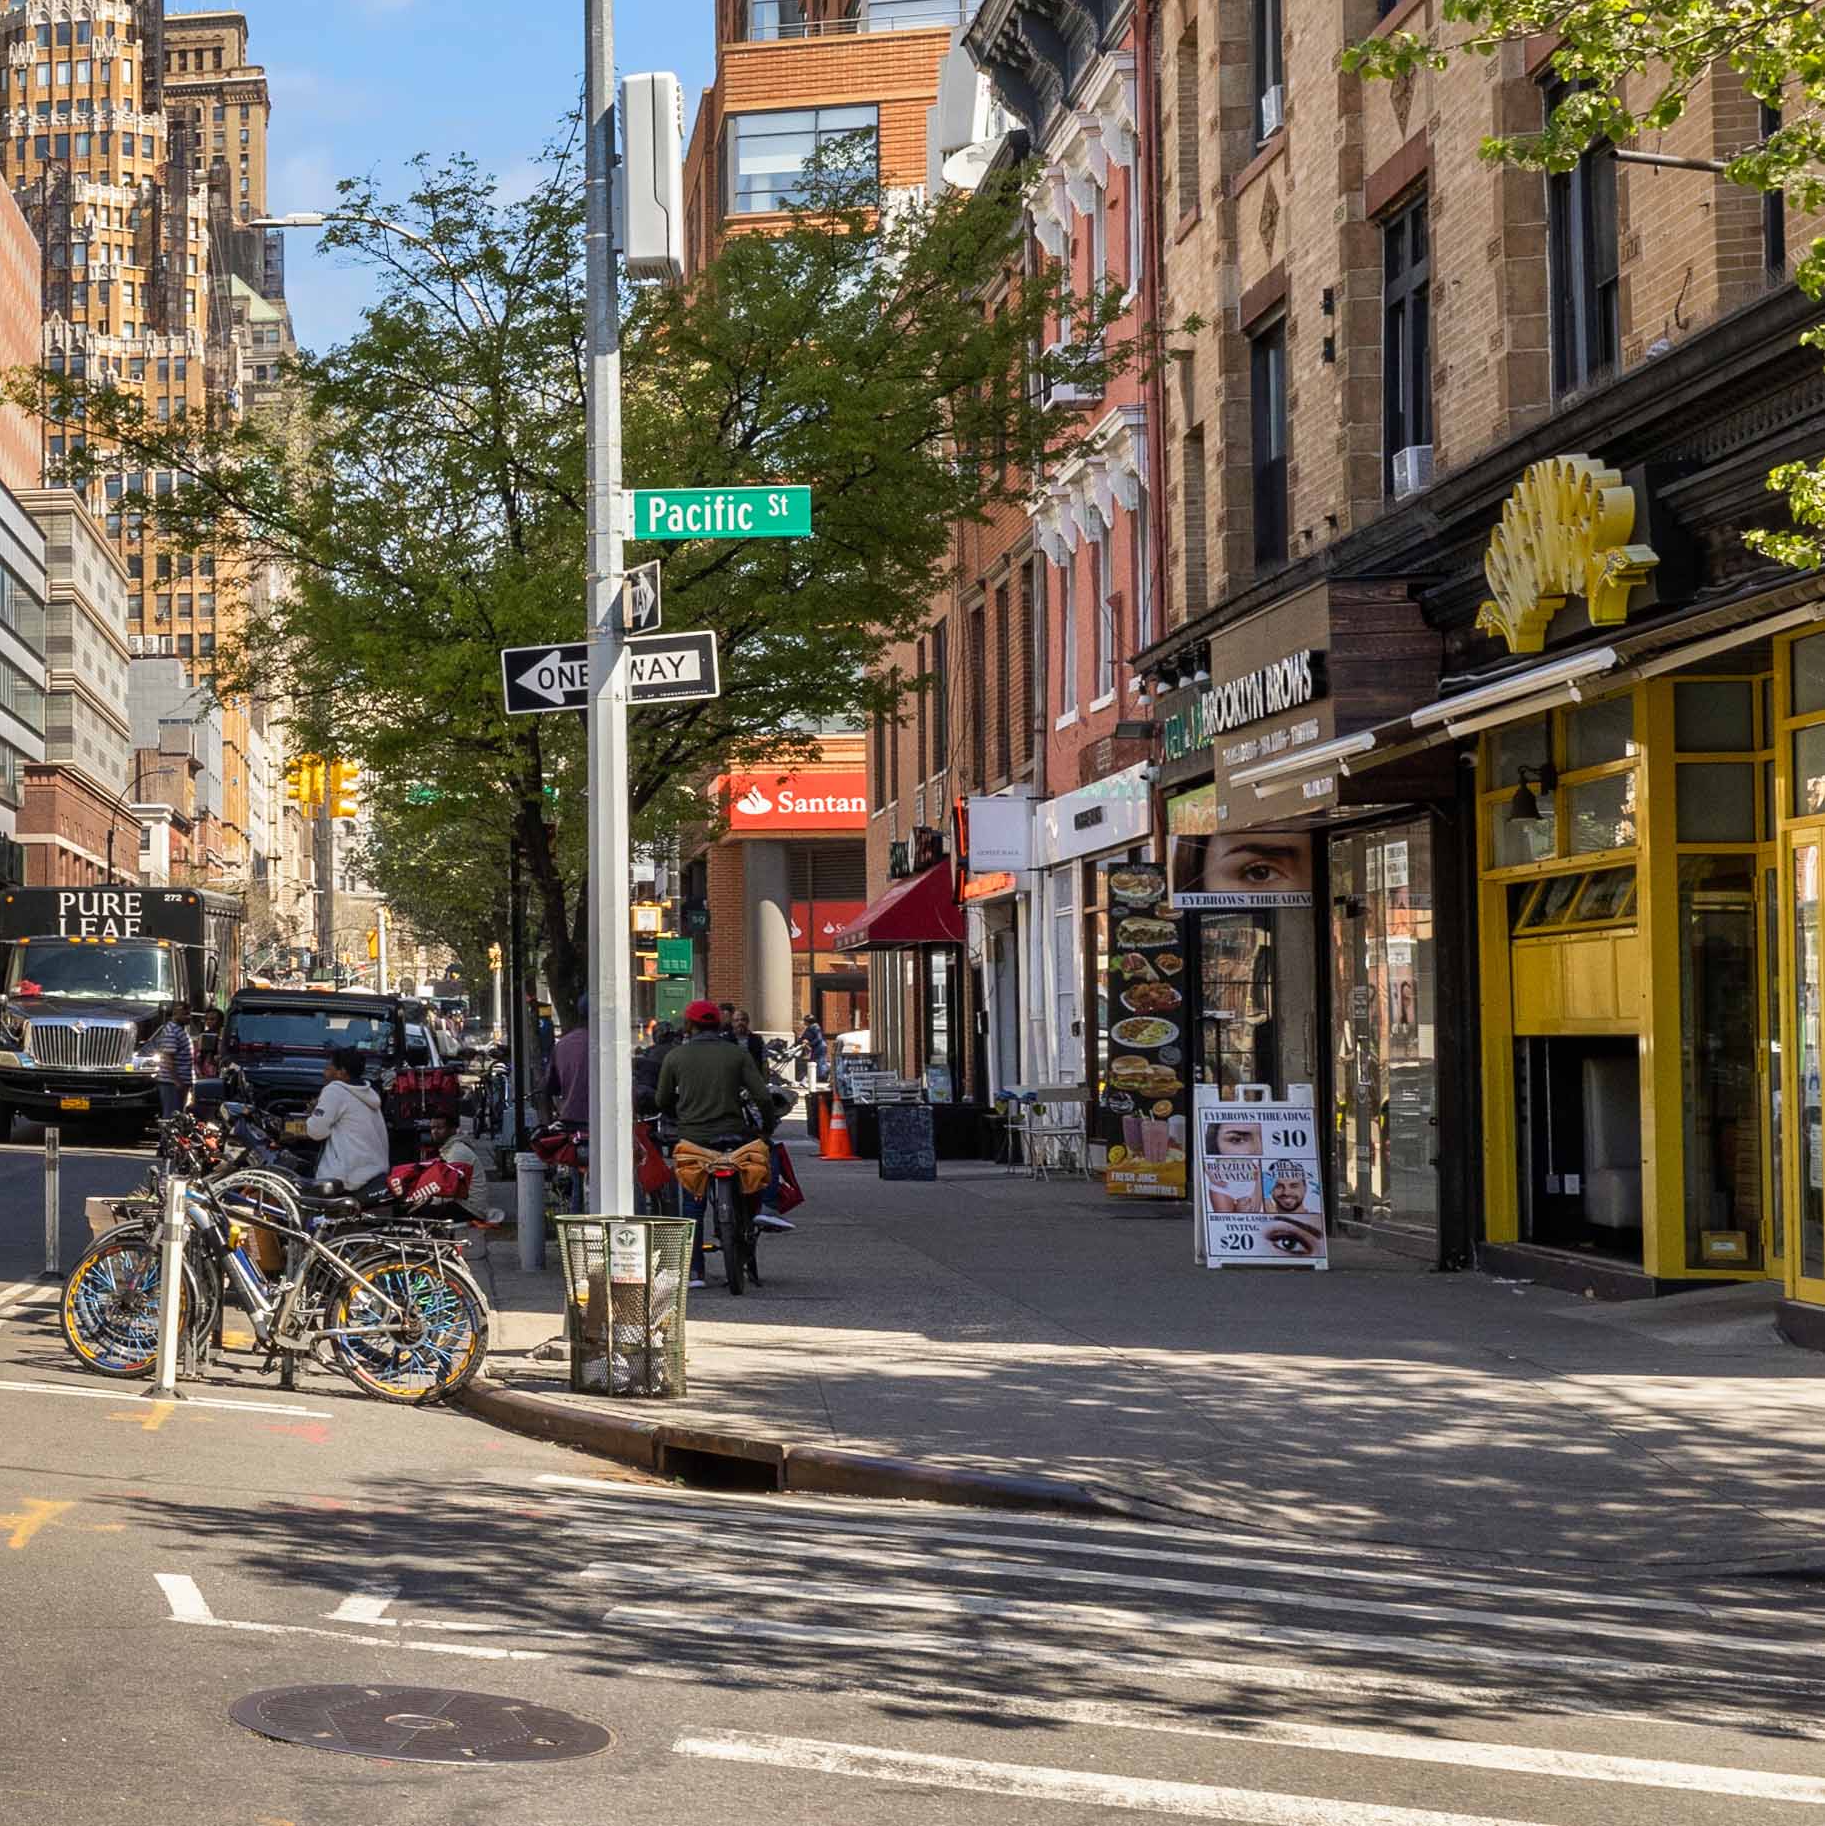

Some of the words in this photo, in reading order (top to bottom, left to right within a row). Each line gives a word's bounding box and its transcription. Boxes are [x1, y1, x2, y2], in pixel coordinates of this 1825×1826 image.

[649, 495, 754, 533] Pacific
[768, 493, 789, 516] St
[537, 662, 588, 690] ONE
[1202, 670, 1264, 736] BROOKLYN
[1265, 649, 1312, 714] BROWS
[777, 790, 867, 813] Santan
[58, 891, 143, 916] PURE
[163, 893, 183, 902] 272
[1181, 895, 1245, 906] EYEBROWS
[1249, 893, 1313, 906] THREADING
[59, 917, 142, 937] LEAF
[1204, 1111, 1255, 1122] EYEBROWS
[1256, 1111, 1311, 1122] THREADING
[1271, 1128, 1307, 1148] $10
[1226, 1223, 1261, 1232] TINTING
[1220, 1232, 1255, 1251] $20
